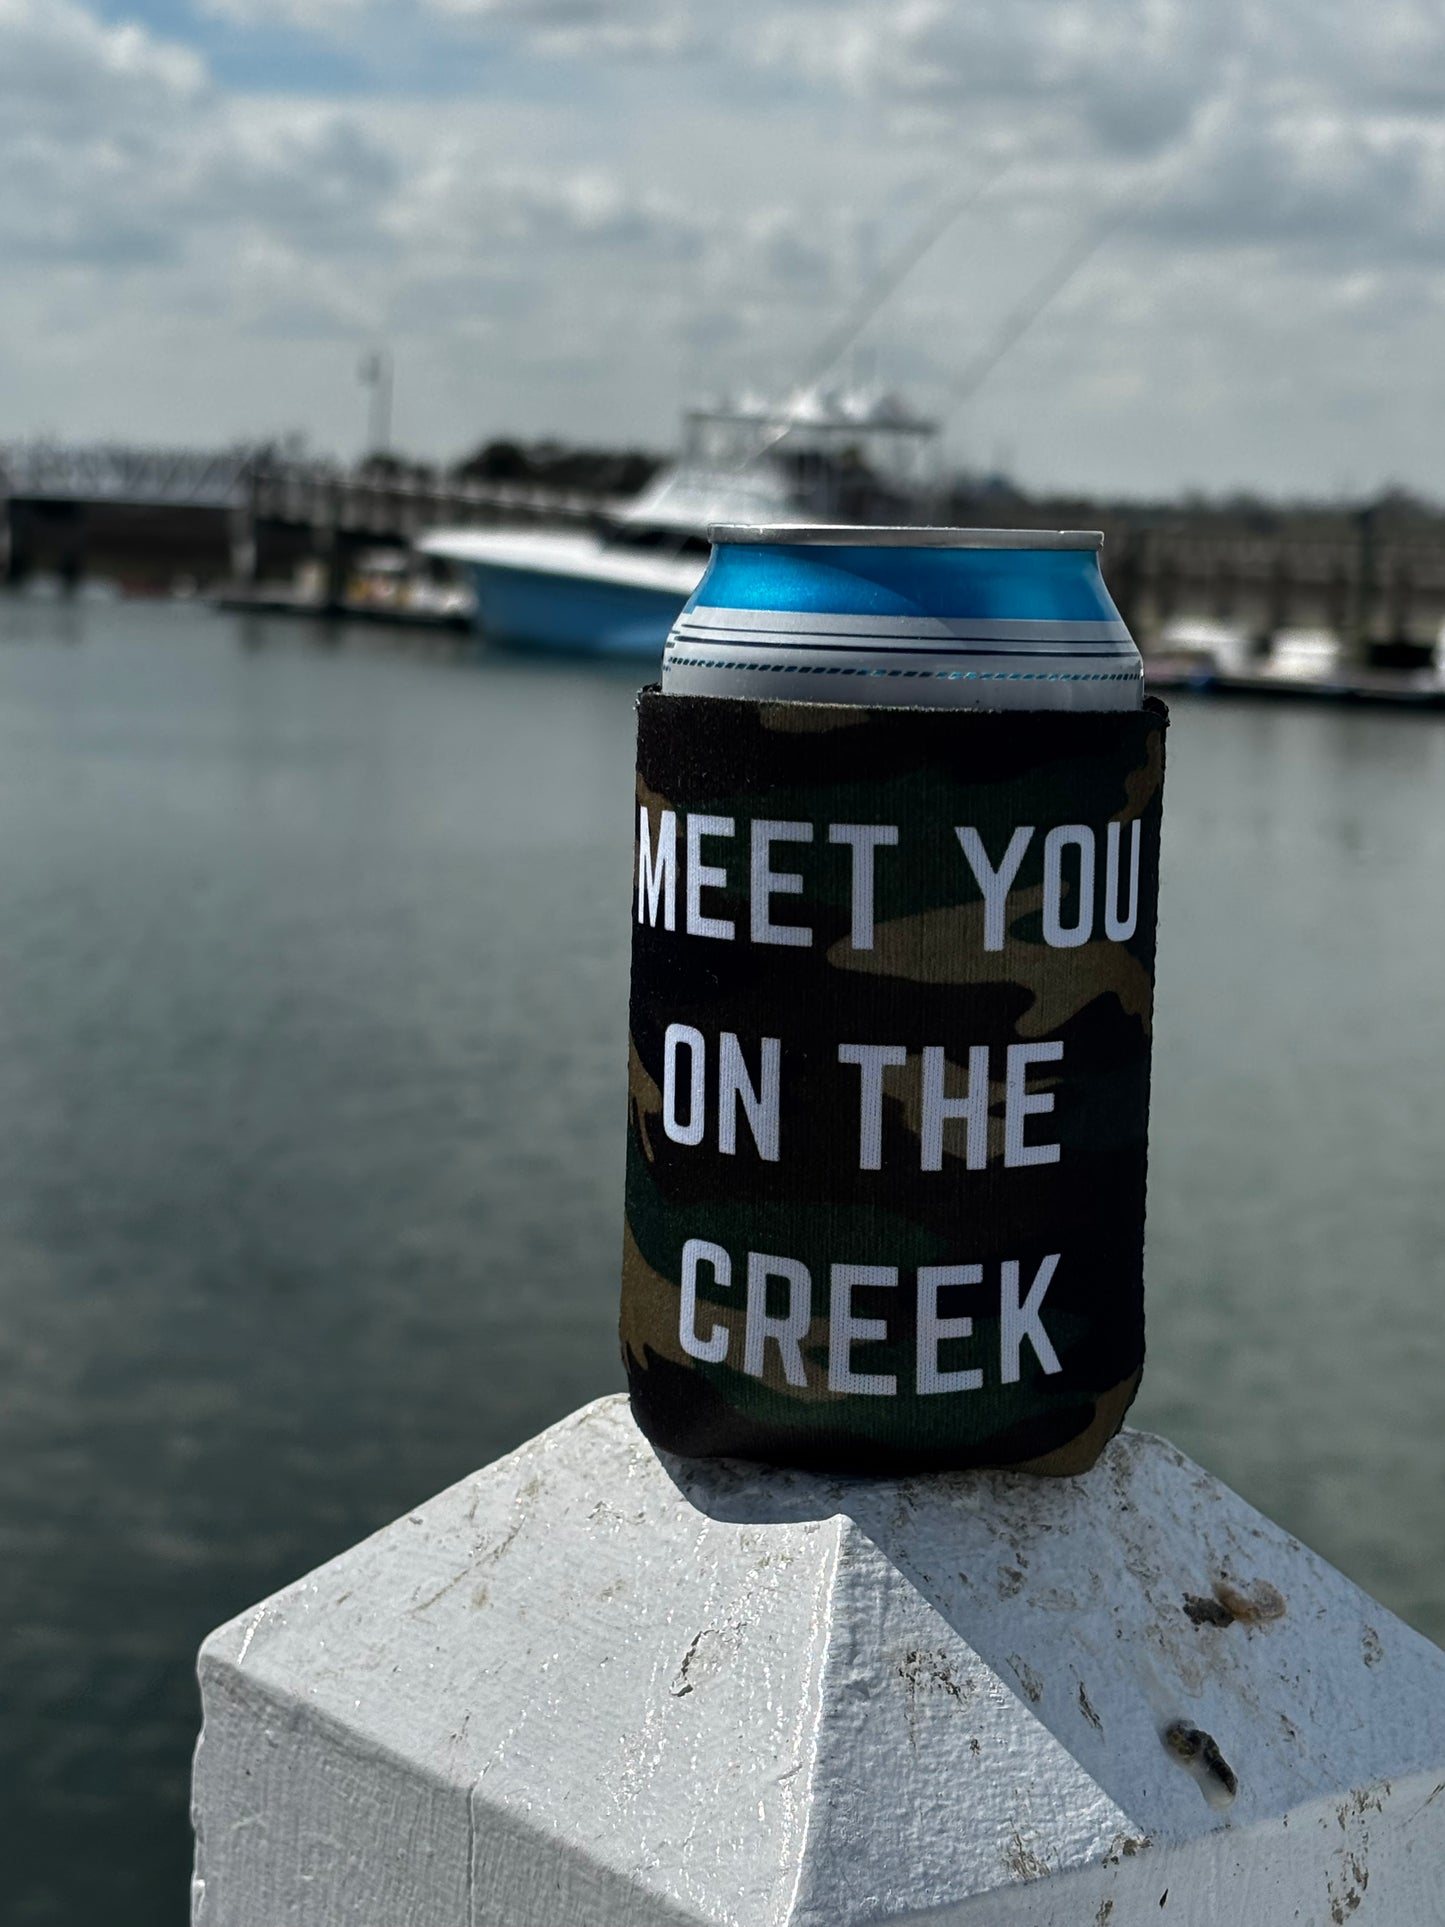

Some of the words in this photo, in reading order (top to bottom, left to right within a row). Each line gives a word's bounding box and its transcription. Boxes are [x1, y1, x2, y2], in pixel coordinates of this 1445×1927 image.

[637, 806, 899, 951] MEET
[955, 818, 1142, 952] YOU
[662, 1023, 781, 1162] ON
[838, 1040, 1064, 1171] THE
[678, 1238, 1064, 1396] CREEK
